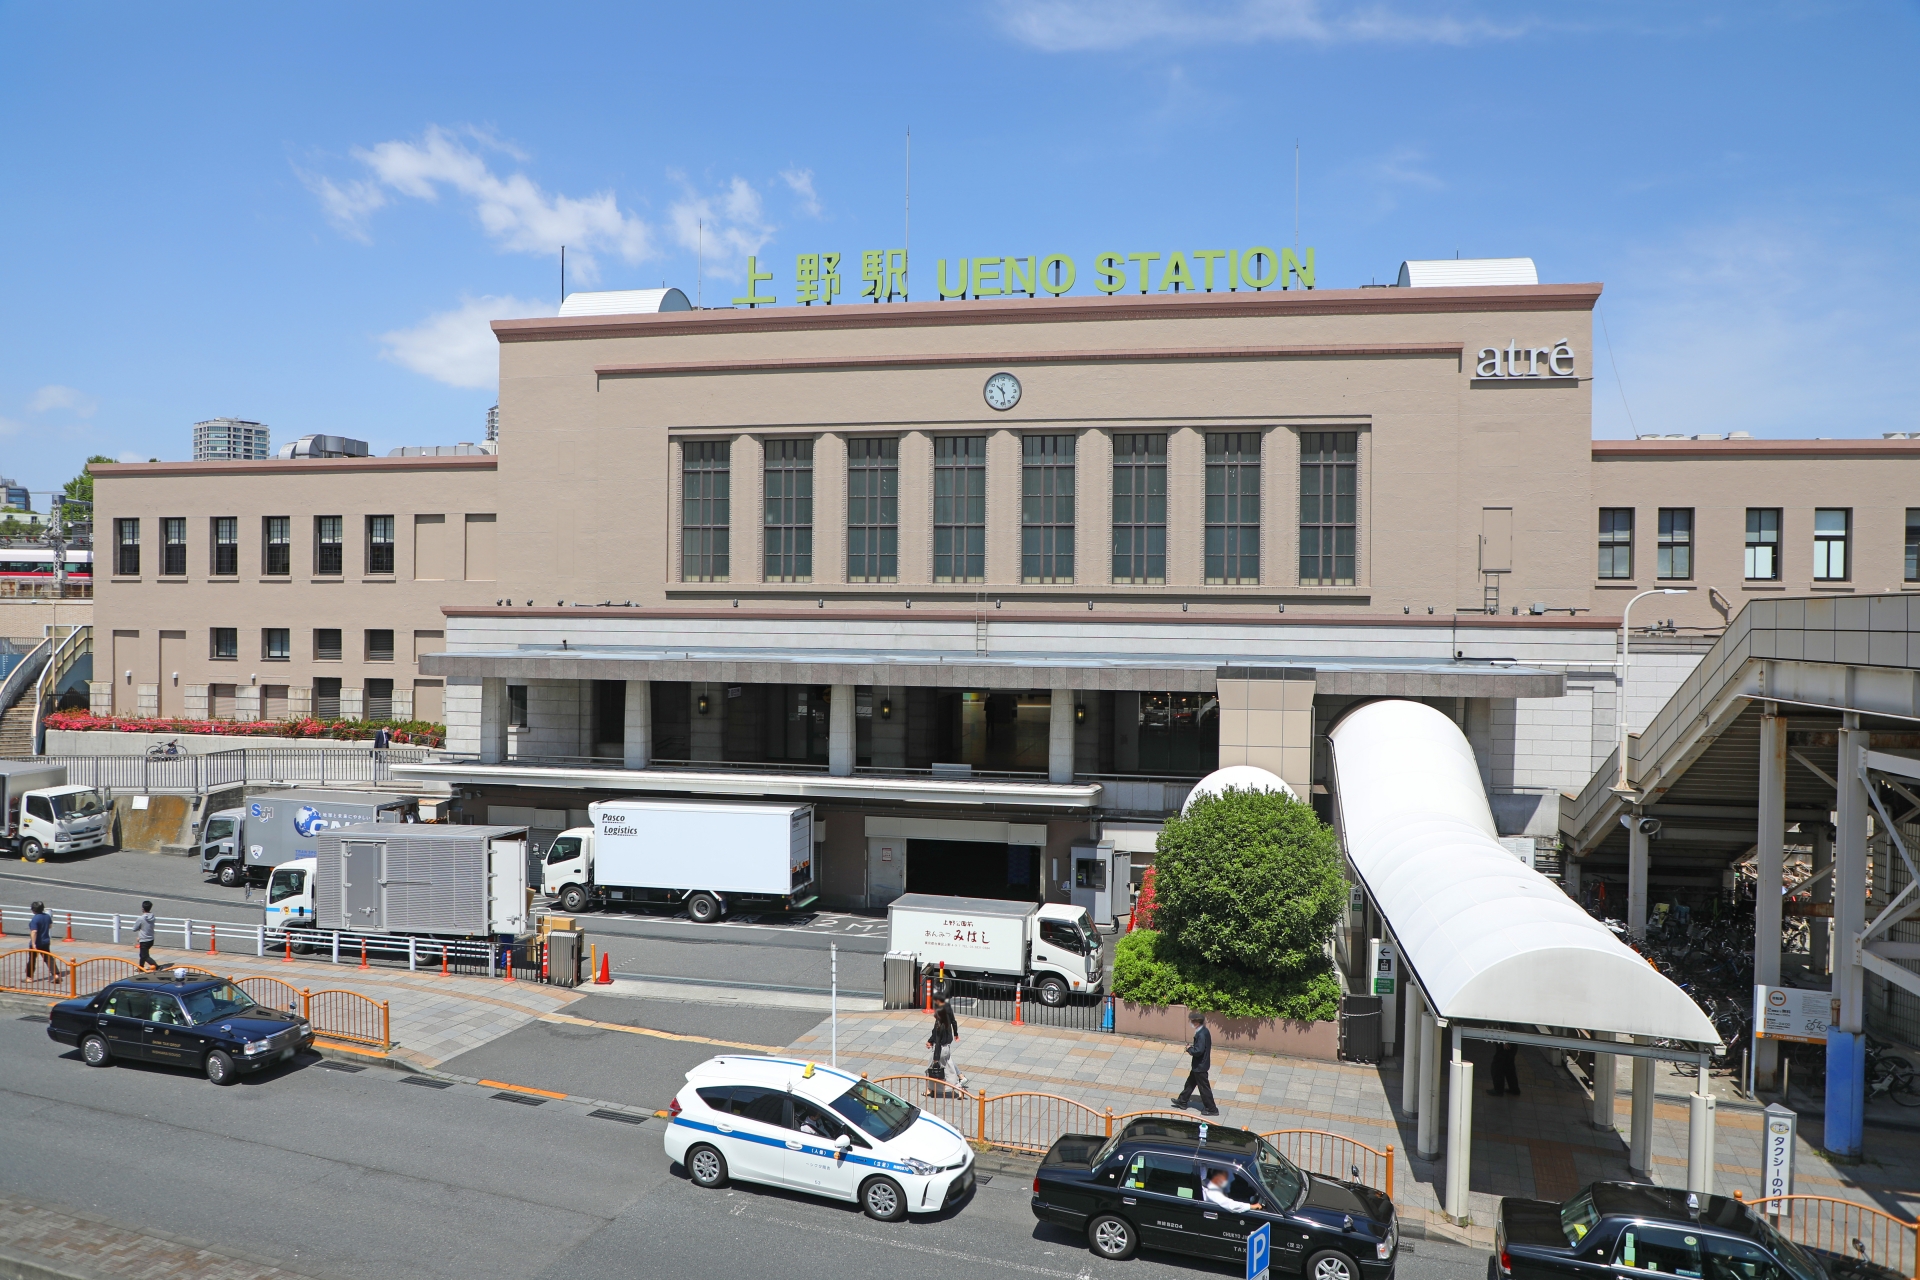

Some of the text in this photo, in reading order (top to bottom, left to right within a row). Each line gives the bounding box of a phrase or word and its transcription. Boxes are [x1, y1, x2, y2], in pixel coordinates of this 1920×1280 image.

[732, 246, 1315, 305] 上野駅 UENO STATION
[1476, 337, 1575, 377] atré
[602, 813, 626, 821] Pasco
[604, 826, 638, 836] Logistics
[954, 929, 990, 944] みはし
[1253, 1233, 1266, 1273] P
